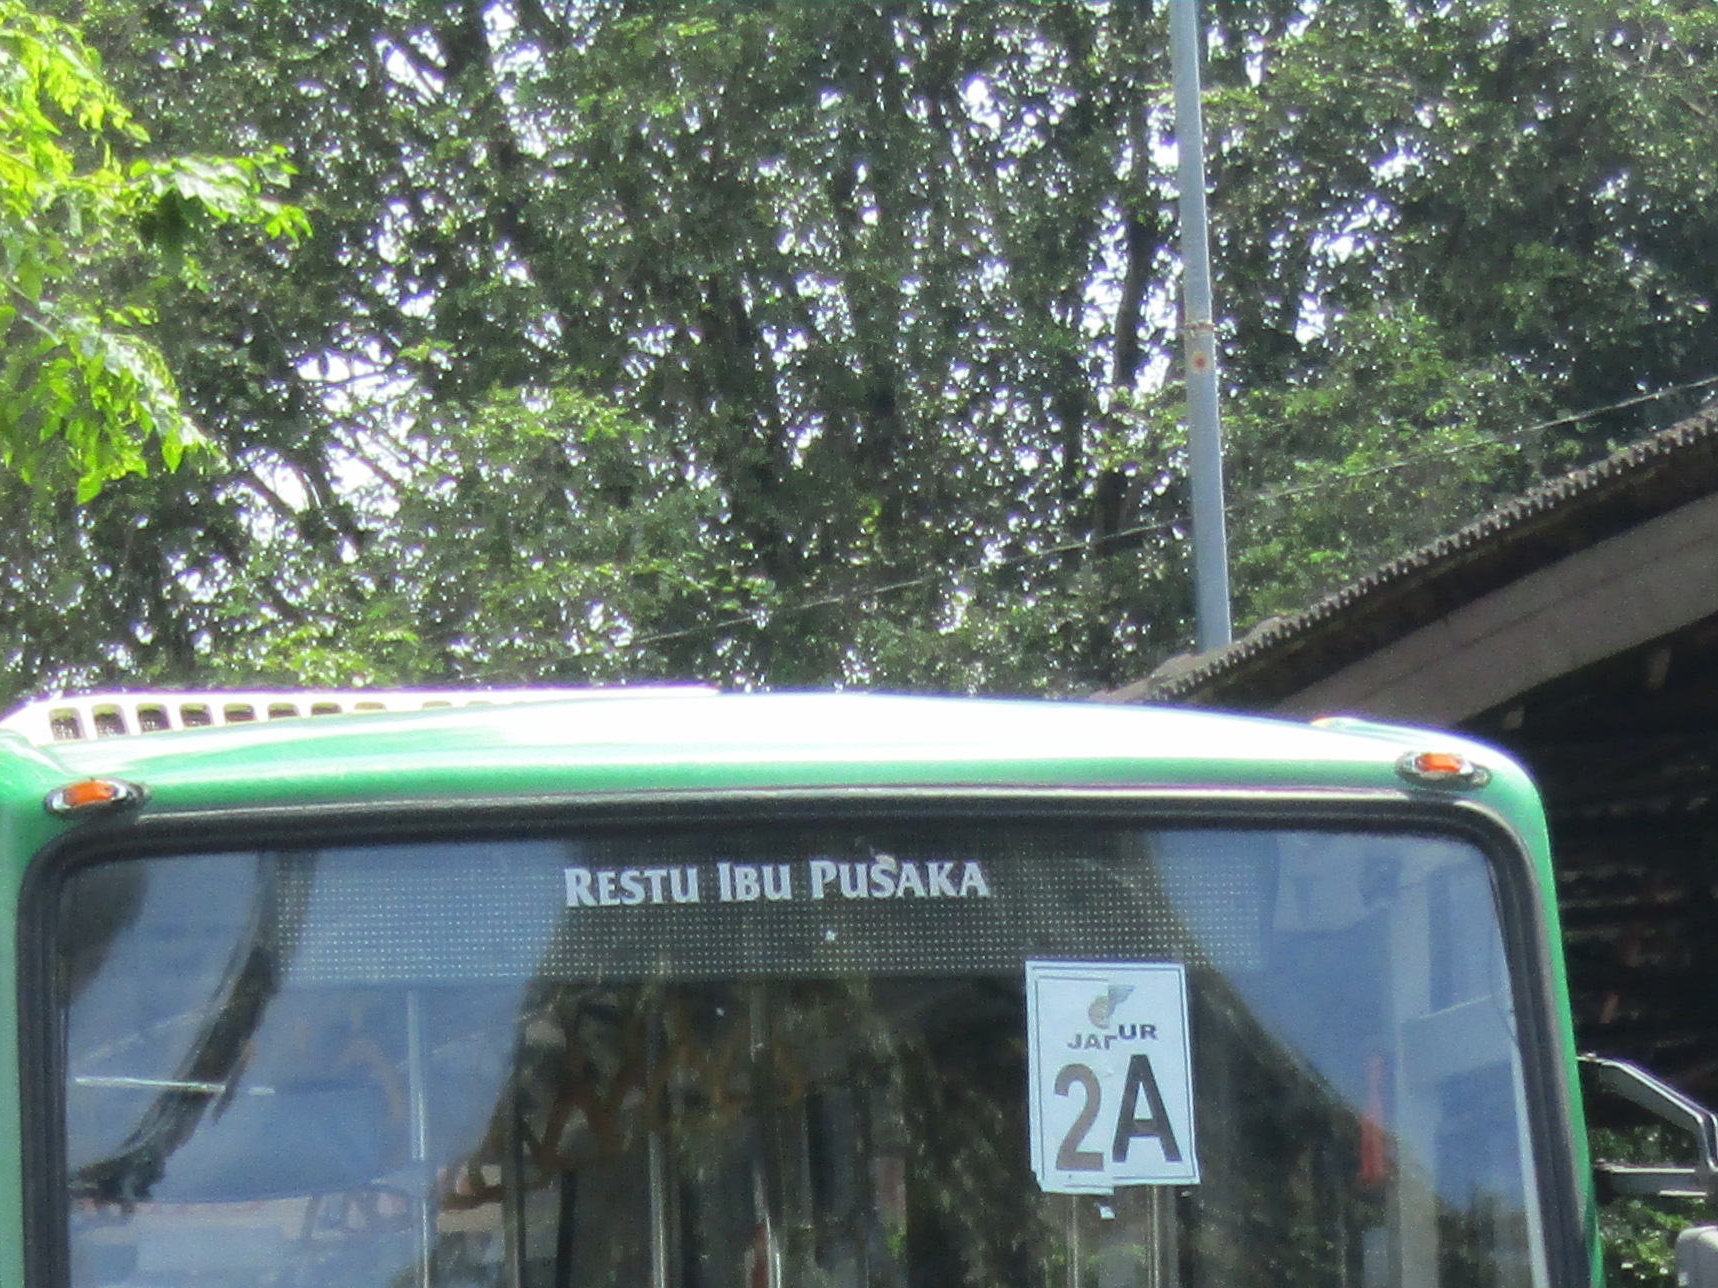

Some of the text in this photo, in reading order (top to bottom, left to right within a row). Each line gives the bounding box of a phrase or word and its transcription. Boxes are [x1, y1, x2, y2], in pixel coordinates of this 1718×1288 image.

[564, 856, 990, 907] RESTU IBU PUSAKA
[1052, 1053, 1182, 1172] 2A
